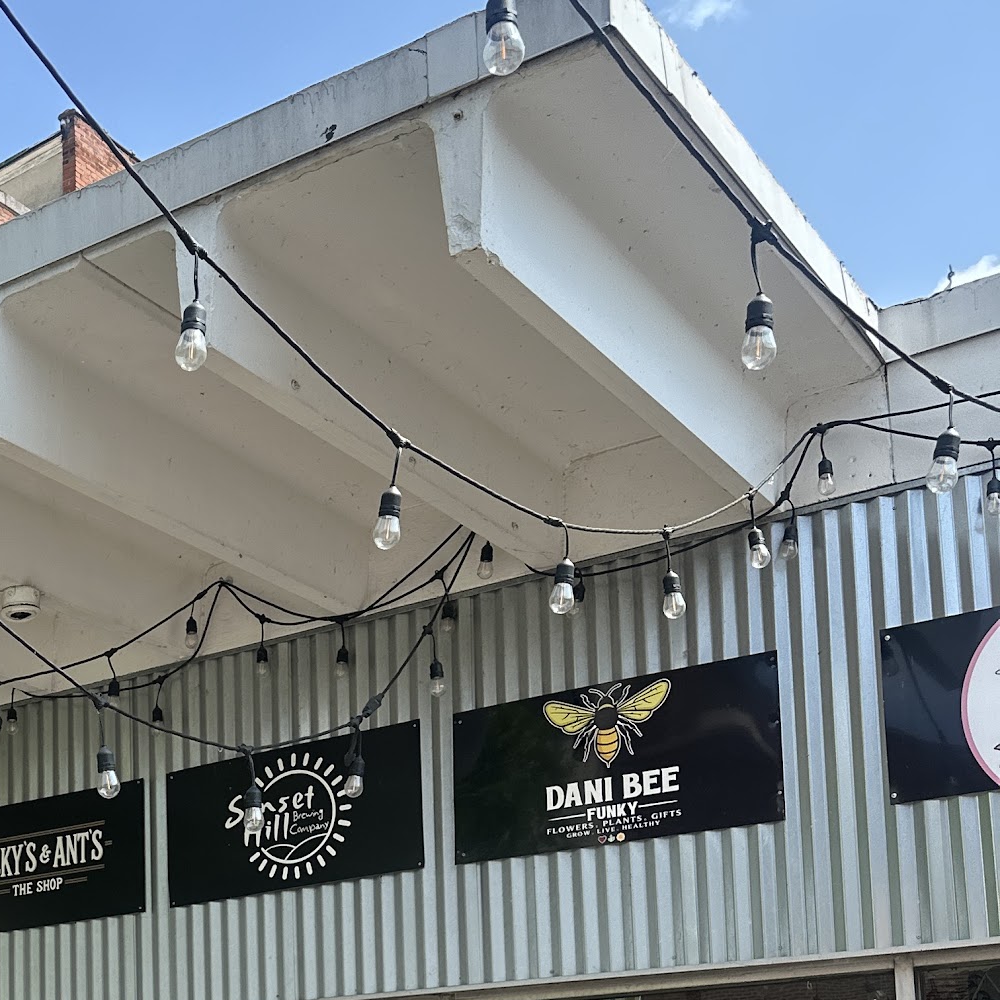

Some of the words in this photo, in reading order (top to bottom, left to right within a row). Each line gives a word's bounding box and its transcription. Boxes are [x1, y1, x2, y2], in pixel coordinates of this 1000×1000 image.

[546, 776, 613, 811] DANI
[622, 766, 680, 799] BEE
[224, 785, 314, 829] Snset
[292, 808, 324, 822] Brewing
[587, 801, 638, 822] FUNKY
[651, 809, 682, 819] GIFTS
[289, 820, 330, 836] Company
[39, 844, 52, 864] &
[52, 828, 104, 868] ANT'S
[12, 882, 33, 897] THE
[36, 877, 63, 892] SHOP
